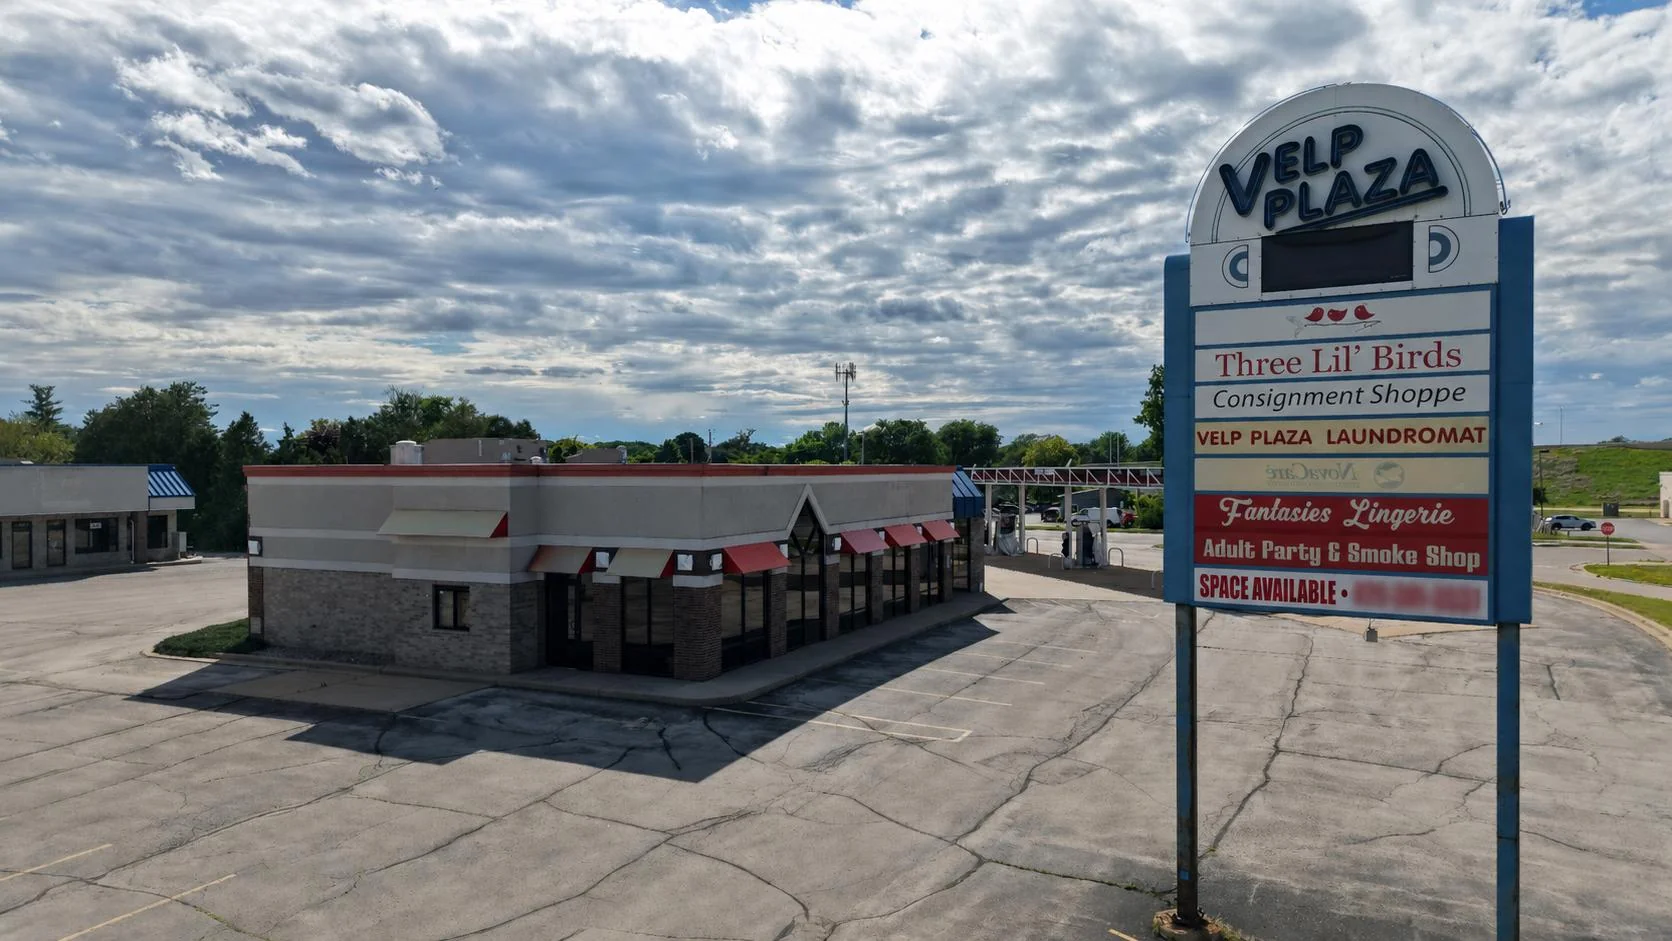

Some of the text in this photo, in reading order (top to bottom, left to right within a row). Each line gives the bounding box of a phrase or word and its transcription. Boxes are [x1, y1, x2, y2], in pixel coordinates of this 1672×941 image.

[1219, 124, 1364, 217] VELP
[1264, 148, 1440, 231] PLAZA
[1215, 352, 1302, 377] Three
[1372, 340, 1462, 371] Birds
[1213, 383, 1466, 412] Consignment Shoppe
[1197, 427, 1487, 446] VELP PLAZA LAUNDROMAT
[1219, 497, 1455, 531] Fantasies Lingerie
[1203, 538, 1481, 572] Adult Party & Smoke Shop
[1199, 573, 1249, 599] SPACE
[1252, 576, 1337, 605] AVAILABLE
